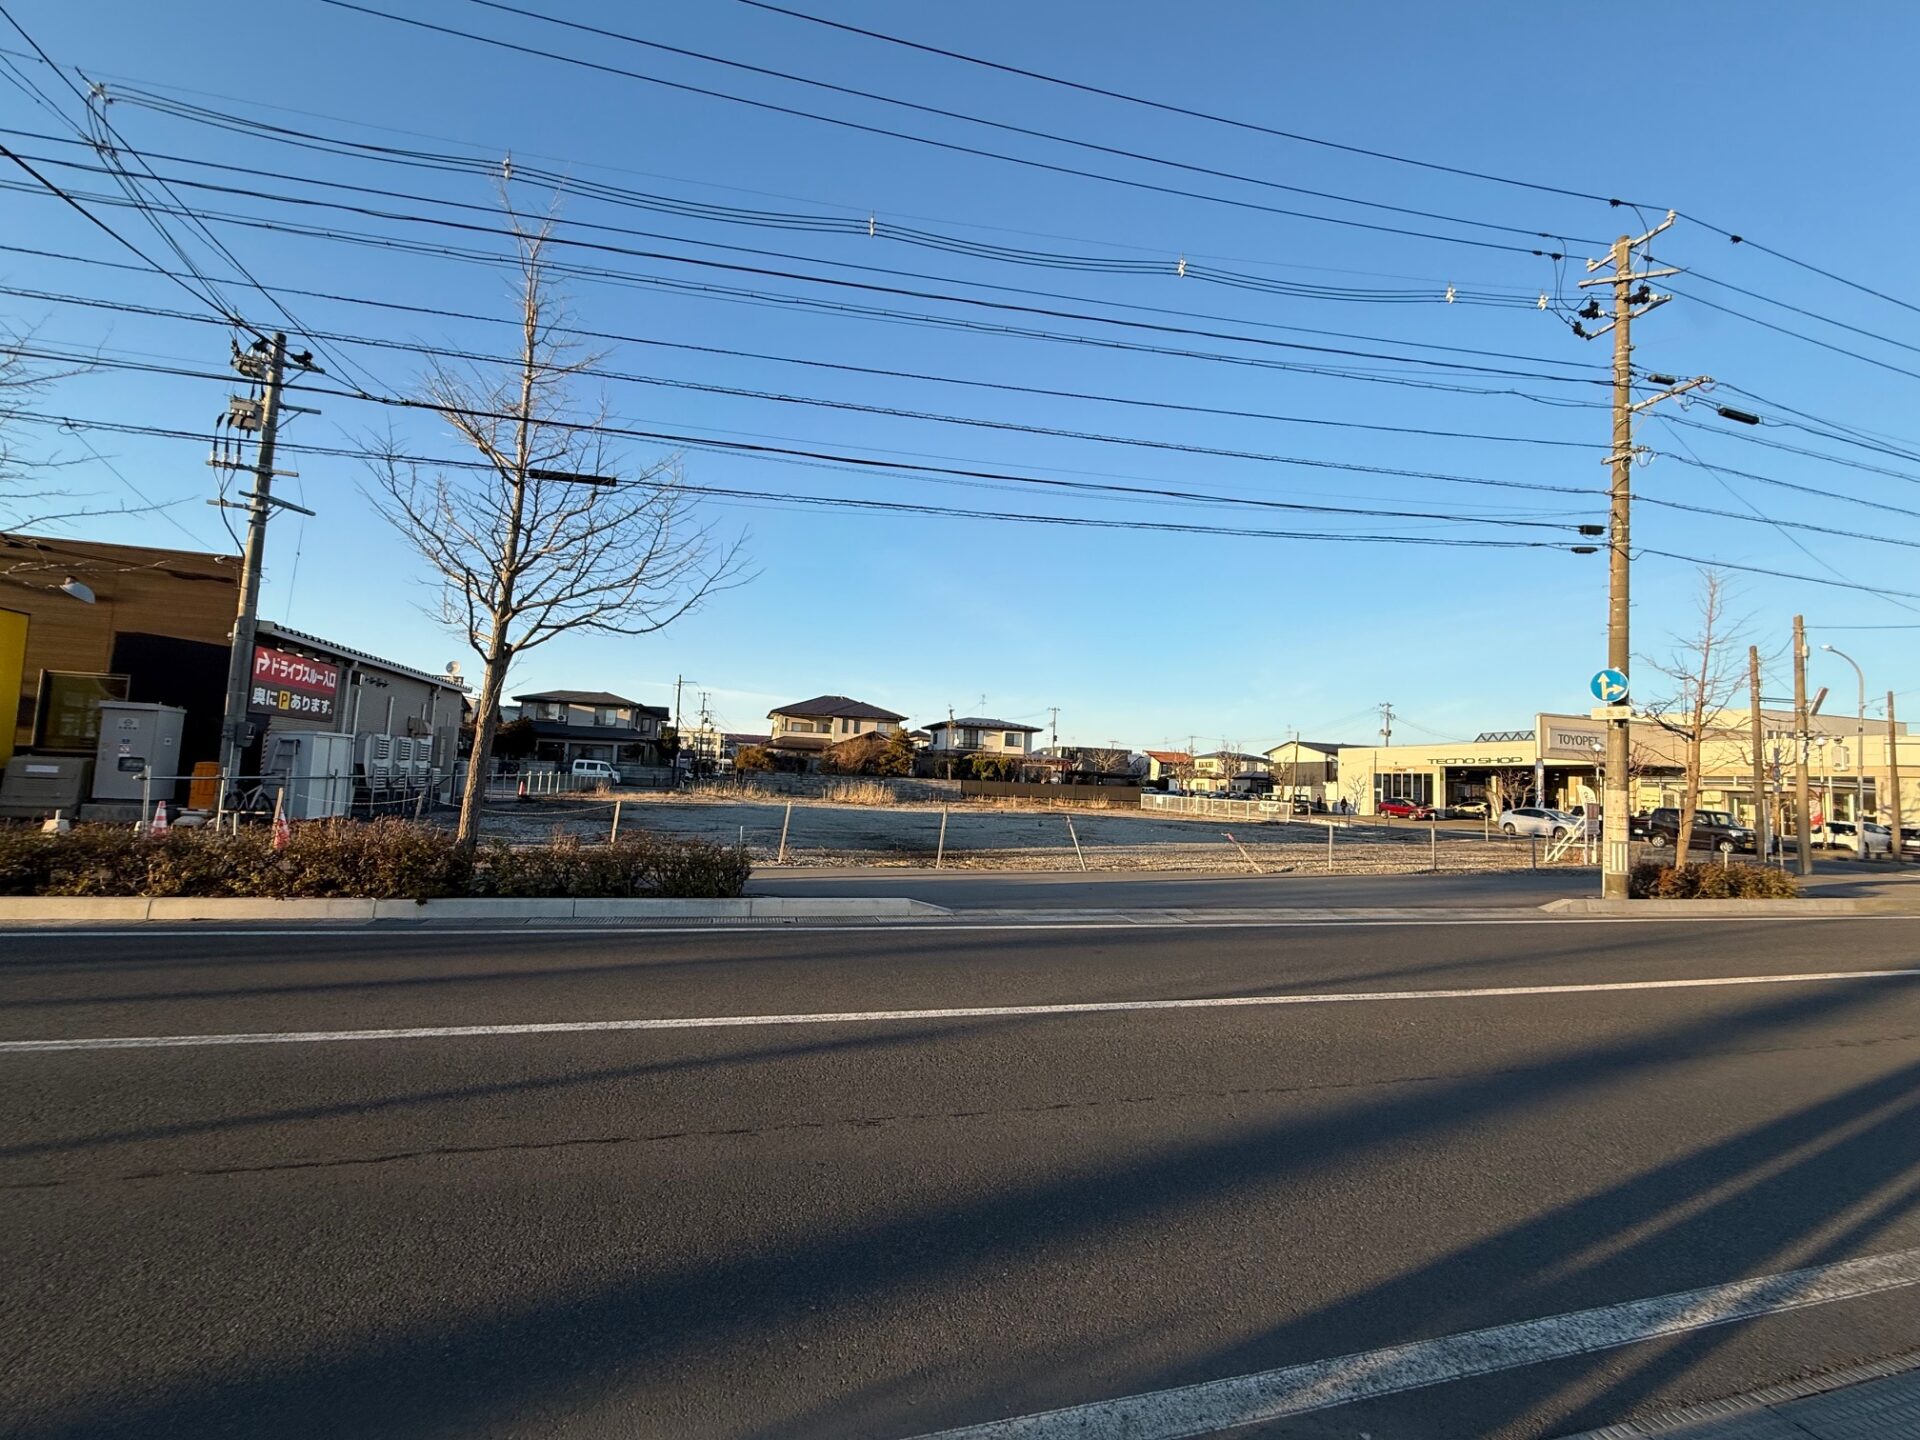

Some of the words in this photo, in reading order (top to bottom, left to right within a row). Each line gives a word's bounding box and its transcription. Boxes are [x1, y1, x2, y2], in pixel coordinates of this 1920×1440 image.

[272, 658, 336, 688] ドライブスルー入口
[1557, 733, 1600, 745] TOYOPET
[1427, 757, 1476, 765] TECNO
[1477, 756, 1523, 764] SHOP
